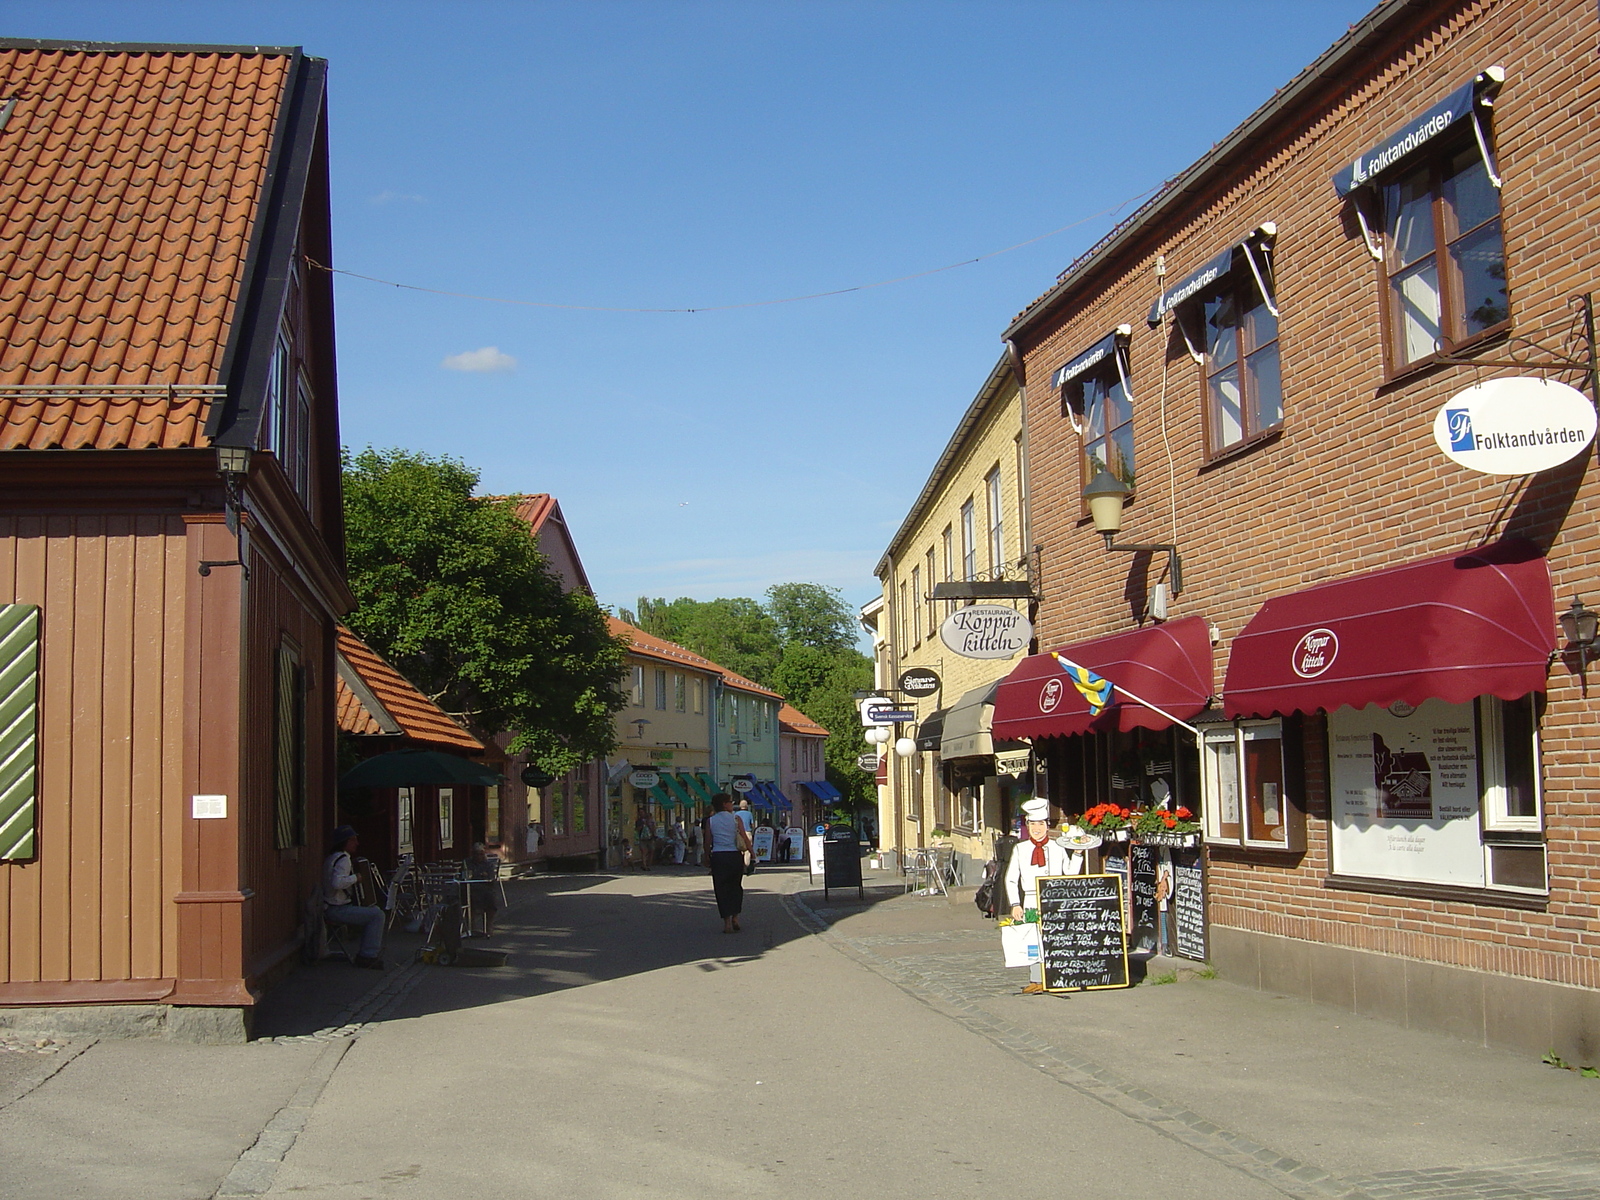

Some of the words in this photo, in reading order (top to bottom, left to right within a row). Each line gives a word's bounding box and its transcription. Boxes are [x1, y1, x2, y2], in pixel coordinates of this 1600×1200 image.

[1369, 110, 1452, 176] folktandvården
[1166, 267, 1218, 310] folktandvården
[1475, 427, 1585, 450] Folktandvården
[953, 612, 1020, 640] Koppar
[963, 629, 1023, 652] kitteln
[1303, 635, 1330, 654] Koppar
[1301, 651, 1325, 672] kitteln
